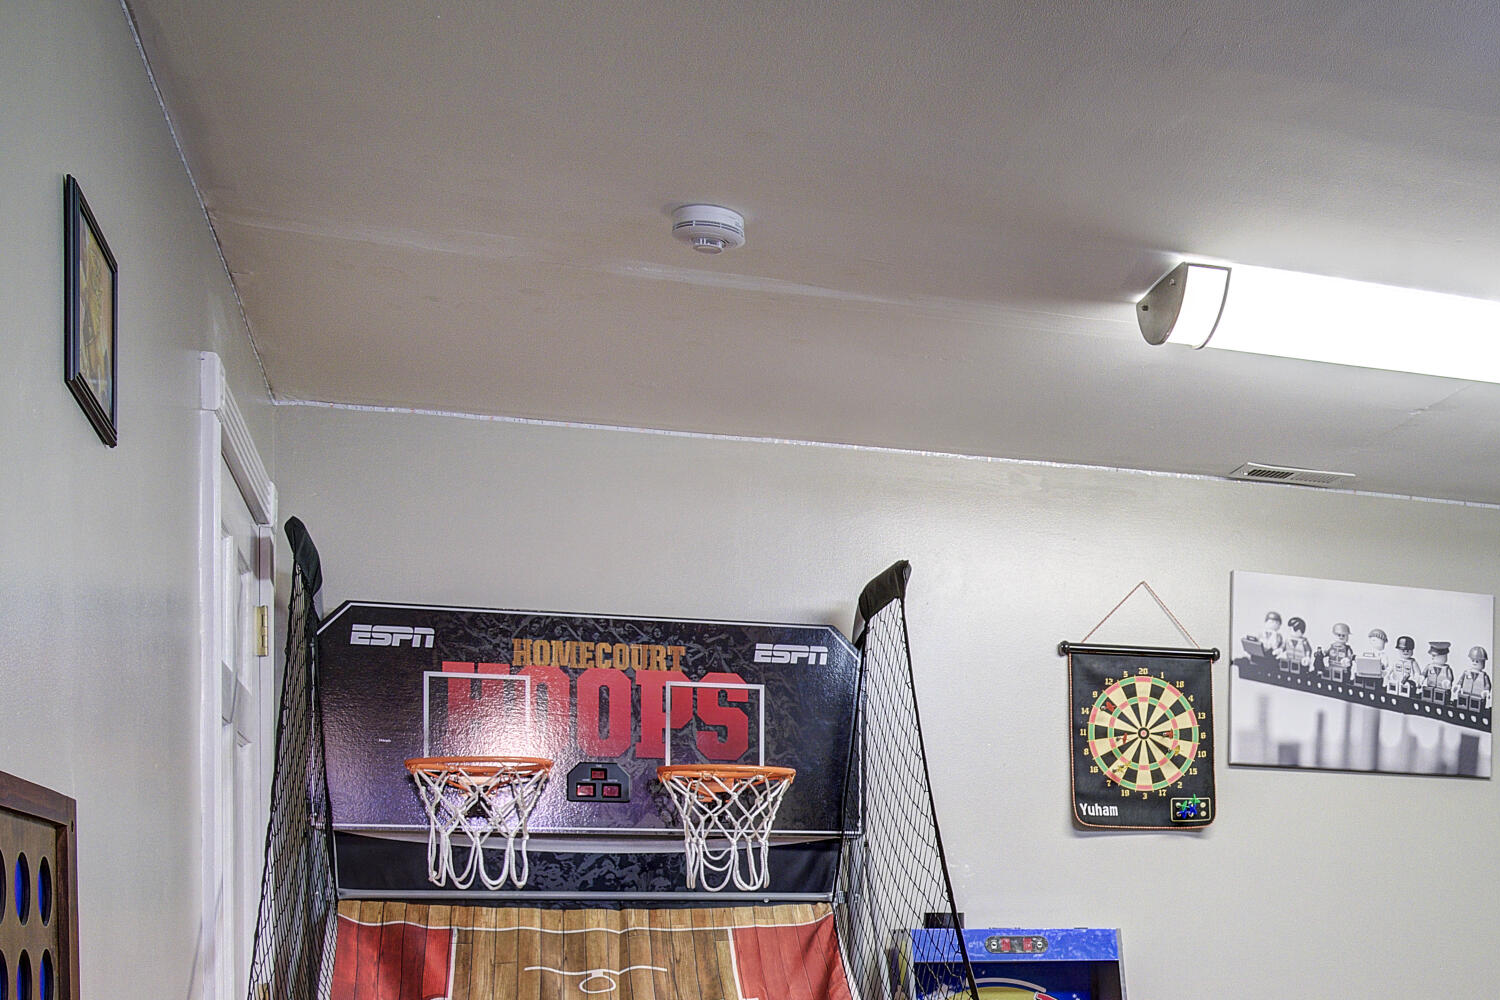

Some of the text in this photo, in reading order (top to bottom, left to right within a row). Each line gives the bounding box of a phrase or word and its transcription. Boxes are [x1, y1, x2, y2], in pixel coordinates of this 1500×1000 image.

[350, 624, 435, 648] ESPN
[511, 638, 686, 672] HOMECOURT
[753, 643, 828, 665] ESPN
[1123, 670, 1129, 678] 5
[1138, 667, 1148, 675] 20
[1081, 707, 1090, 715] 14
[1080, 728, 1087, 736] 11
[1197, 750, 1207, 758] 10
[1079, 802, 1119, 817] Yuham
